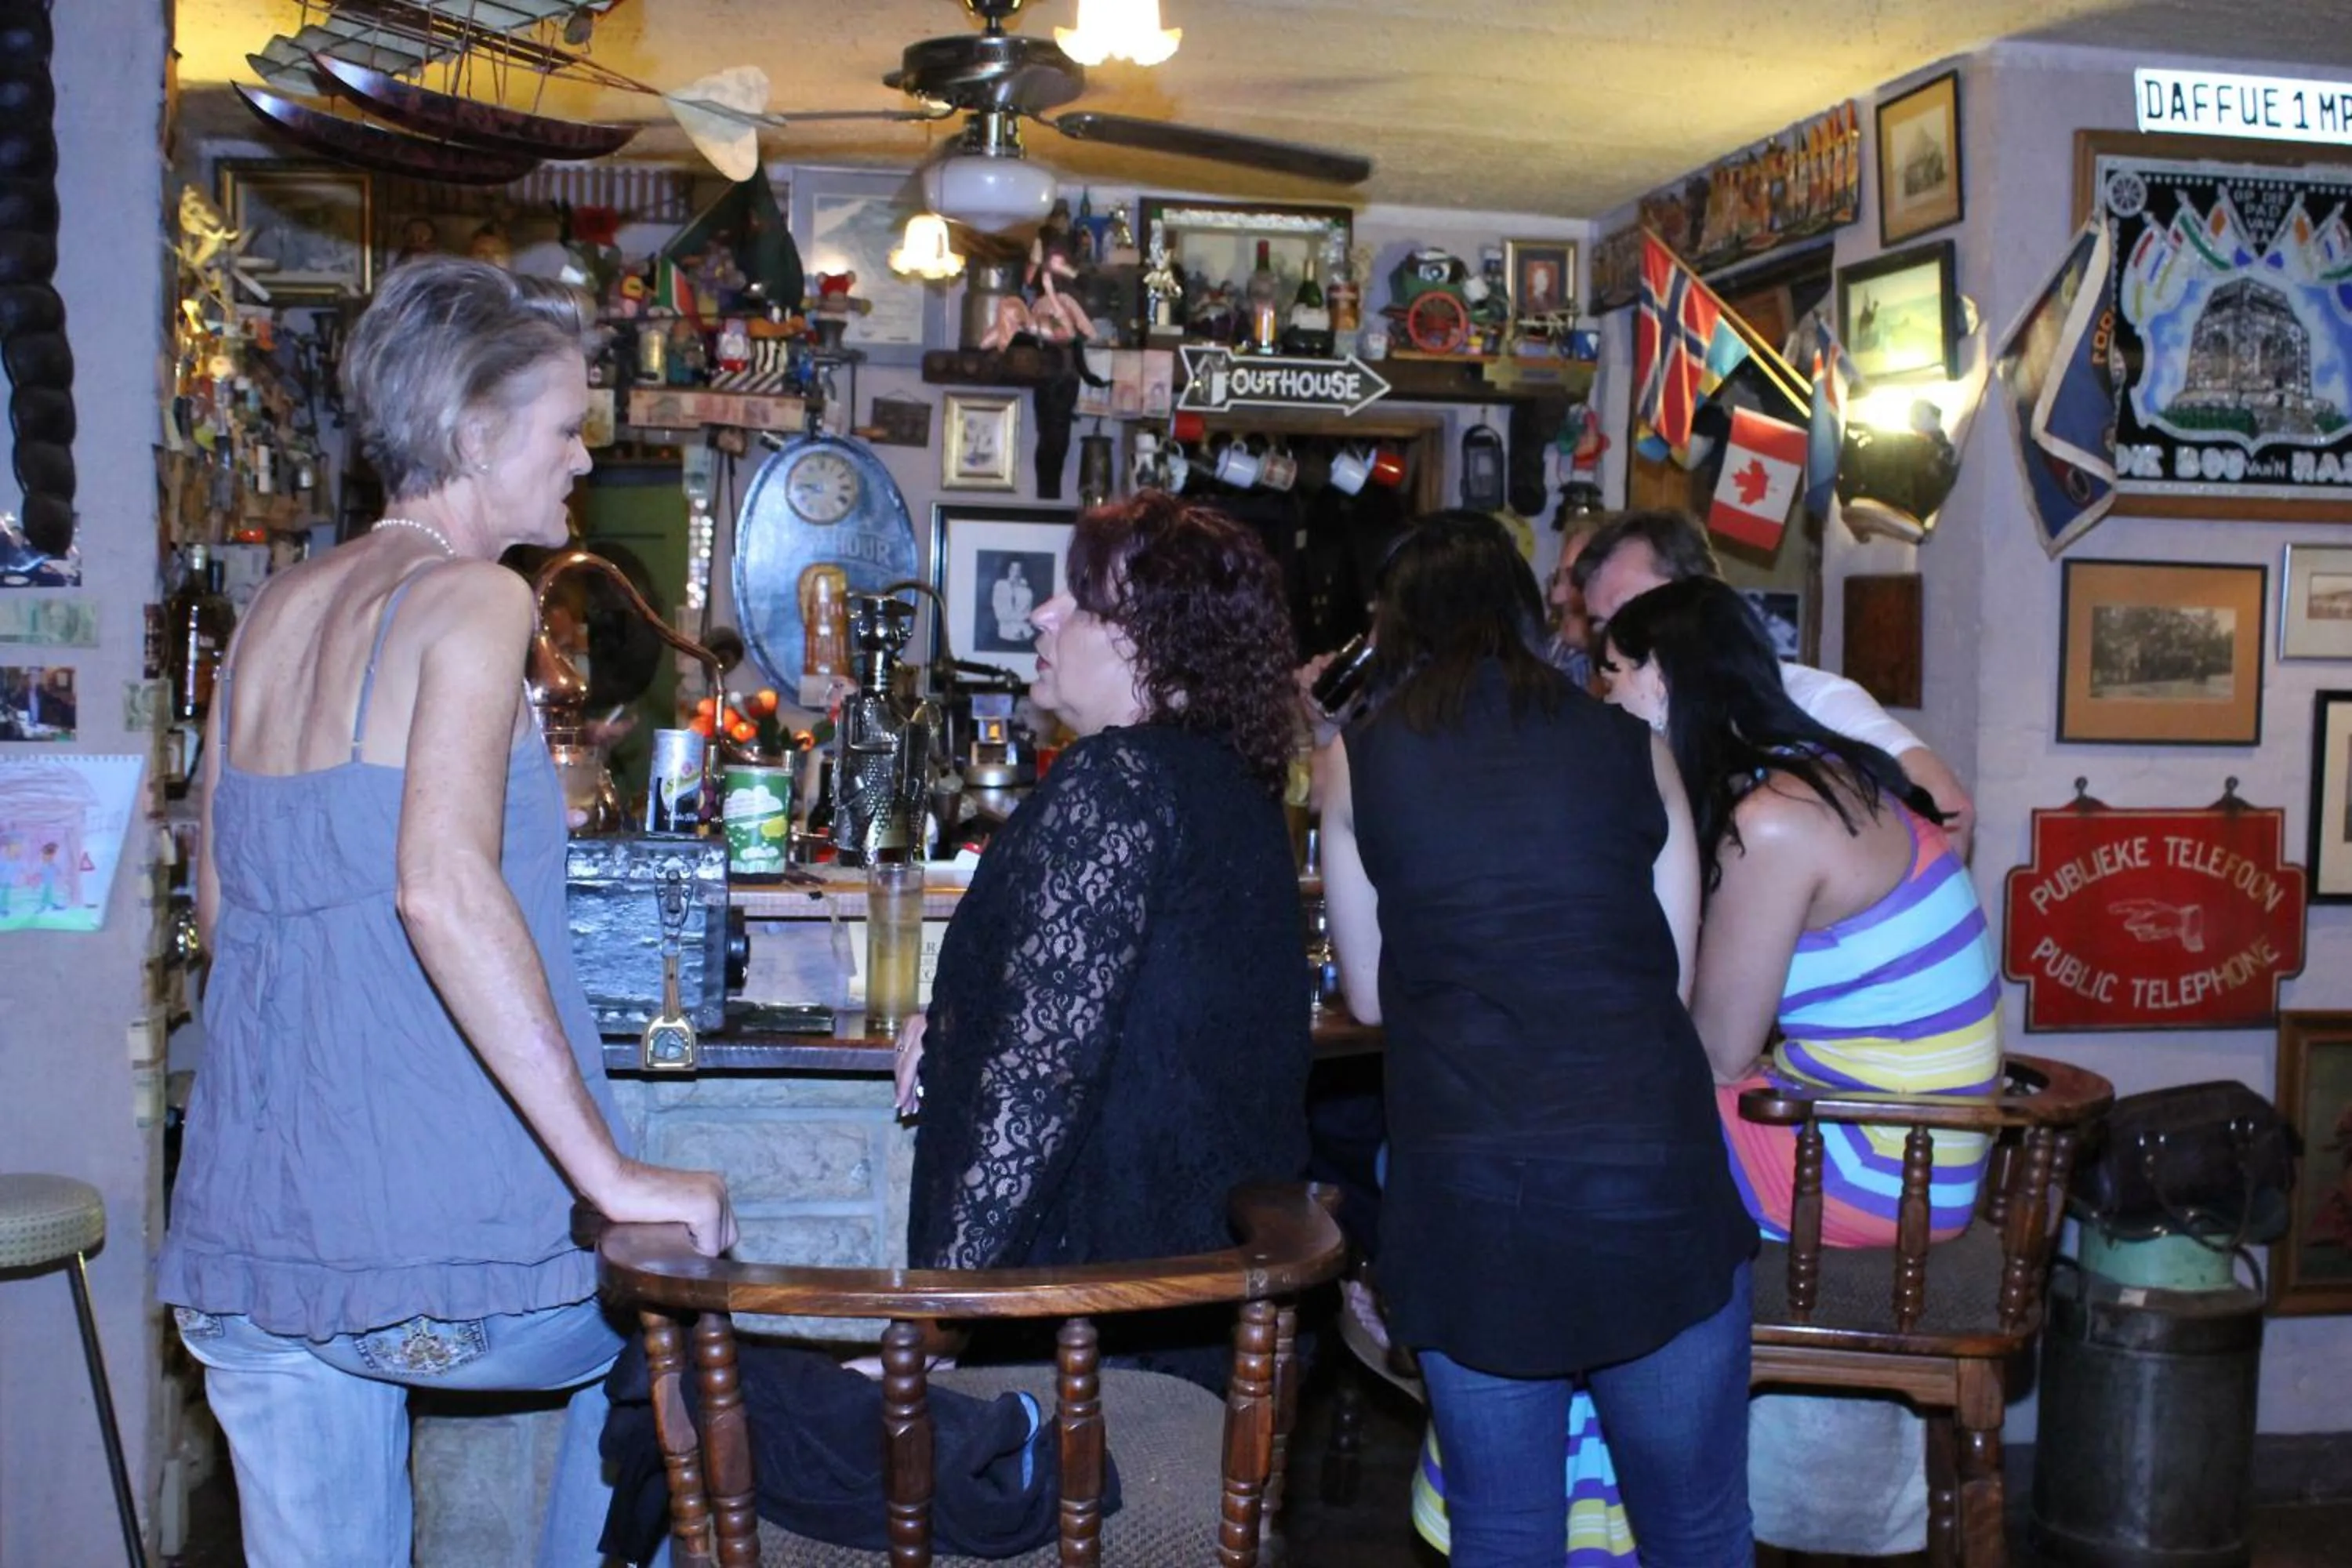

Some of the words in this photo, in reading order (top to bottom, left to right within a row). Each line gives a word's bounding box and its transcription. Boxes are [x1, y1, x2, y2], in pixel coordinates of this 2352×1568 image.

[2144, 79, 2281, 129] DAFFUE
[1231, 367, 1362, 401] OUTHOUSE
[2029, 836, 2151, 916] PUBLIEKE
[2163, 836, 2285, 913] TELEFOON
[2031, 936, 2119, 1004] PUBLIC
[2131, 933, 2281, 1010] TELEPHONE
